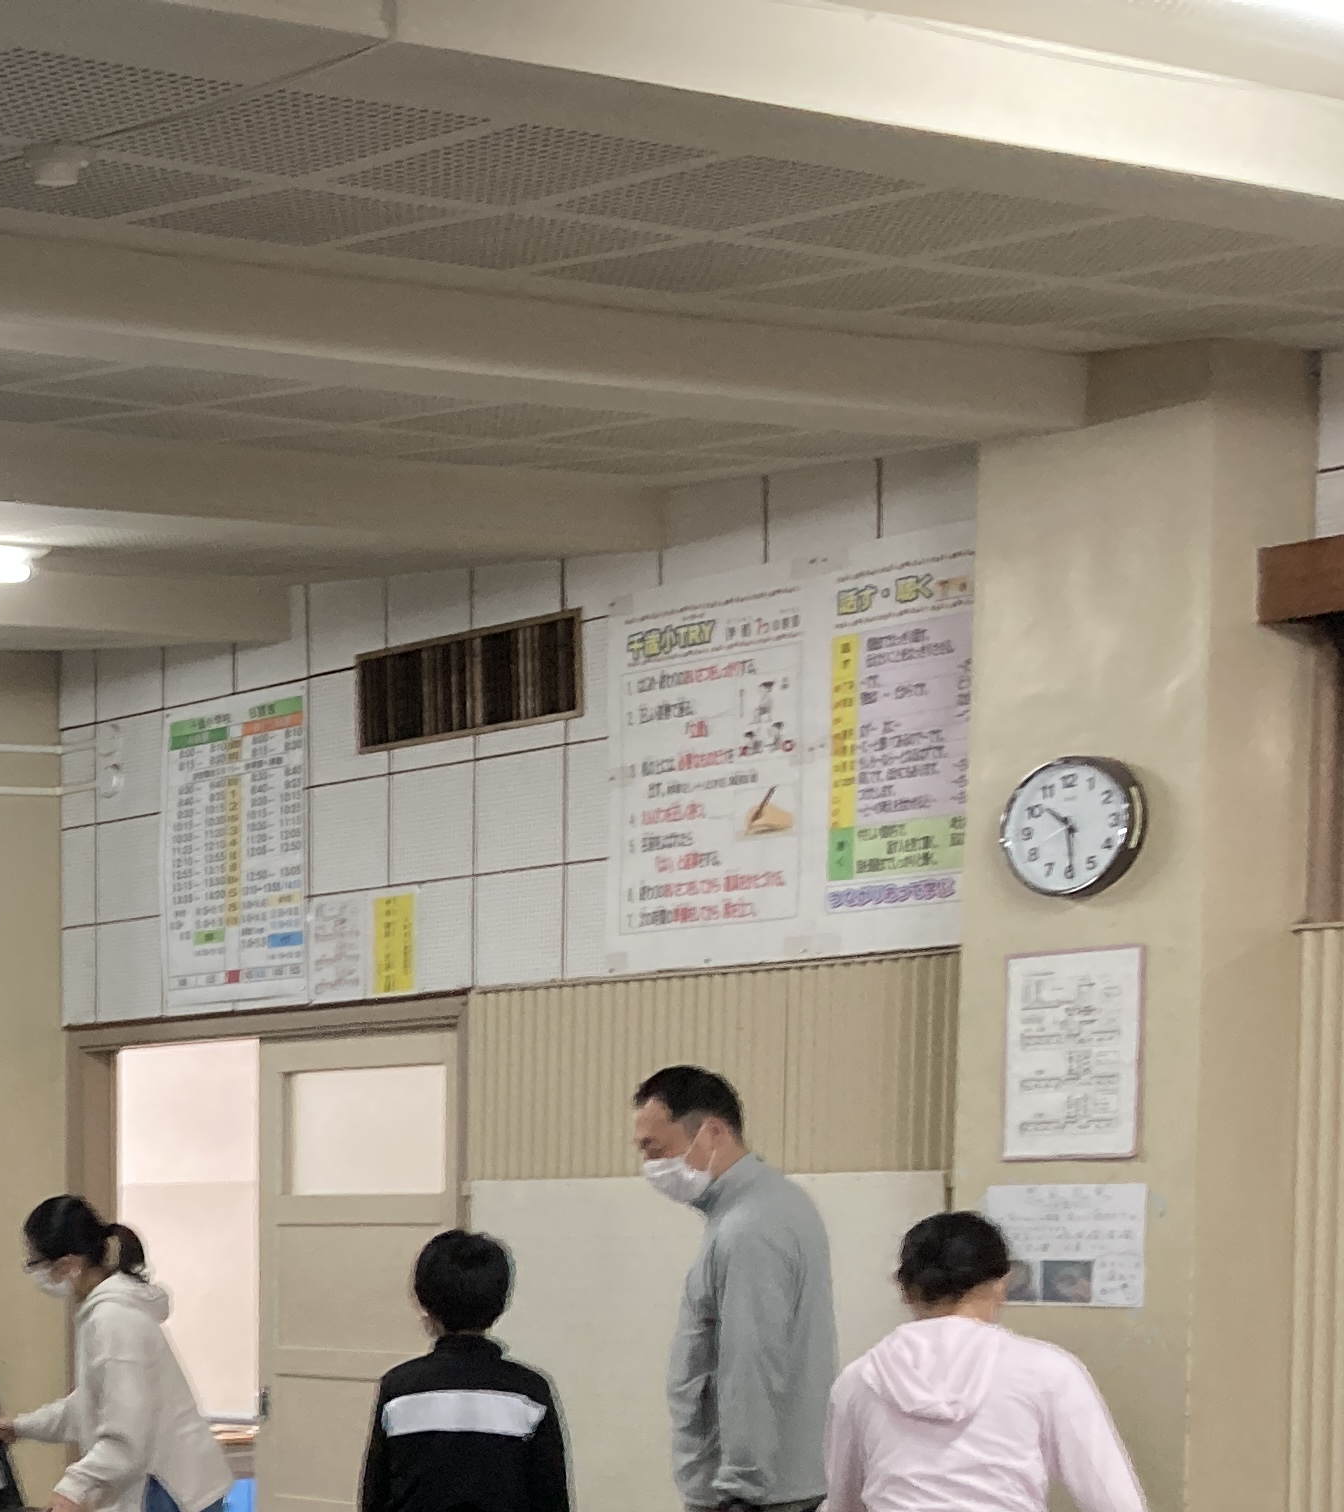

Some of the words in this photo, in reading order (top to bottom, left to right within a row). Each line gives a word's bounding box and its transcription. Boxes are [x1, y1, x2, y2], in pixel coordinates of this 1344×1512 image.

[1060, 773, 1078, 789] 12
[1086, 777, 1096, 791] 1
[1041, 784, 1055, 799] 11
[1101, 789, 1113, 805] 2
[1025, 803, 1044, 820] 10
[1108, 812, 1121, 828] 3
[1021, 827, 1034, 841] 9
[1101, 837, 1113, 849] 4
[1027, 847, 1040, 862] 8
[1044, 862, 1056, 878] 7
[1086, 855, 1097, 870] 5
[1063, 863, 1075, 879] 6
